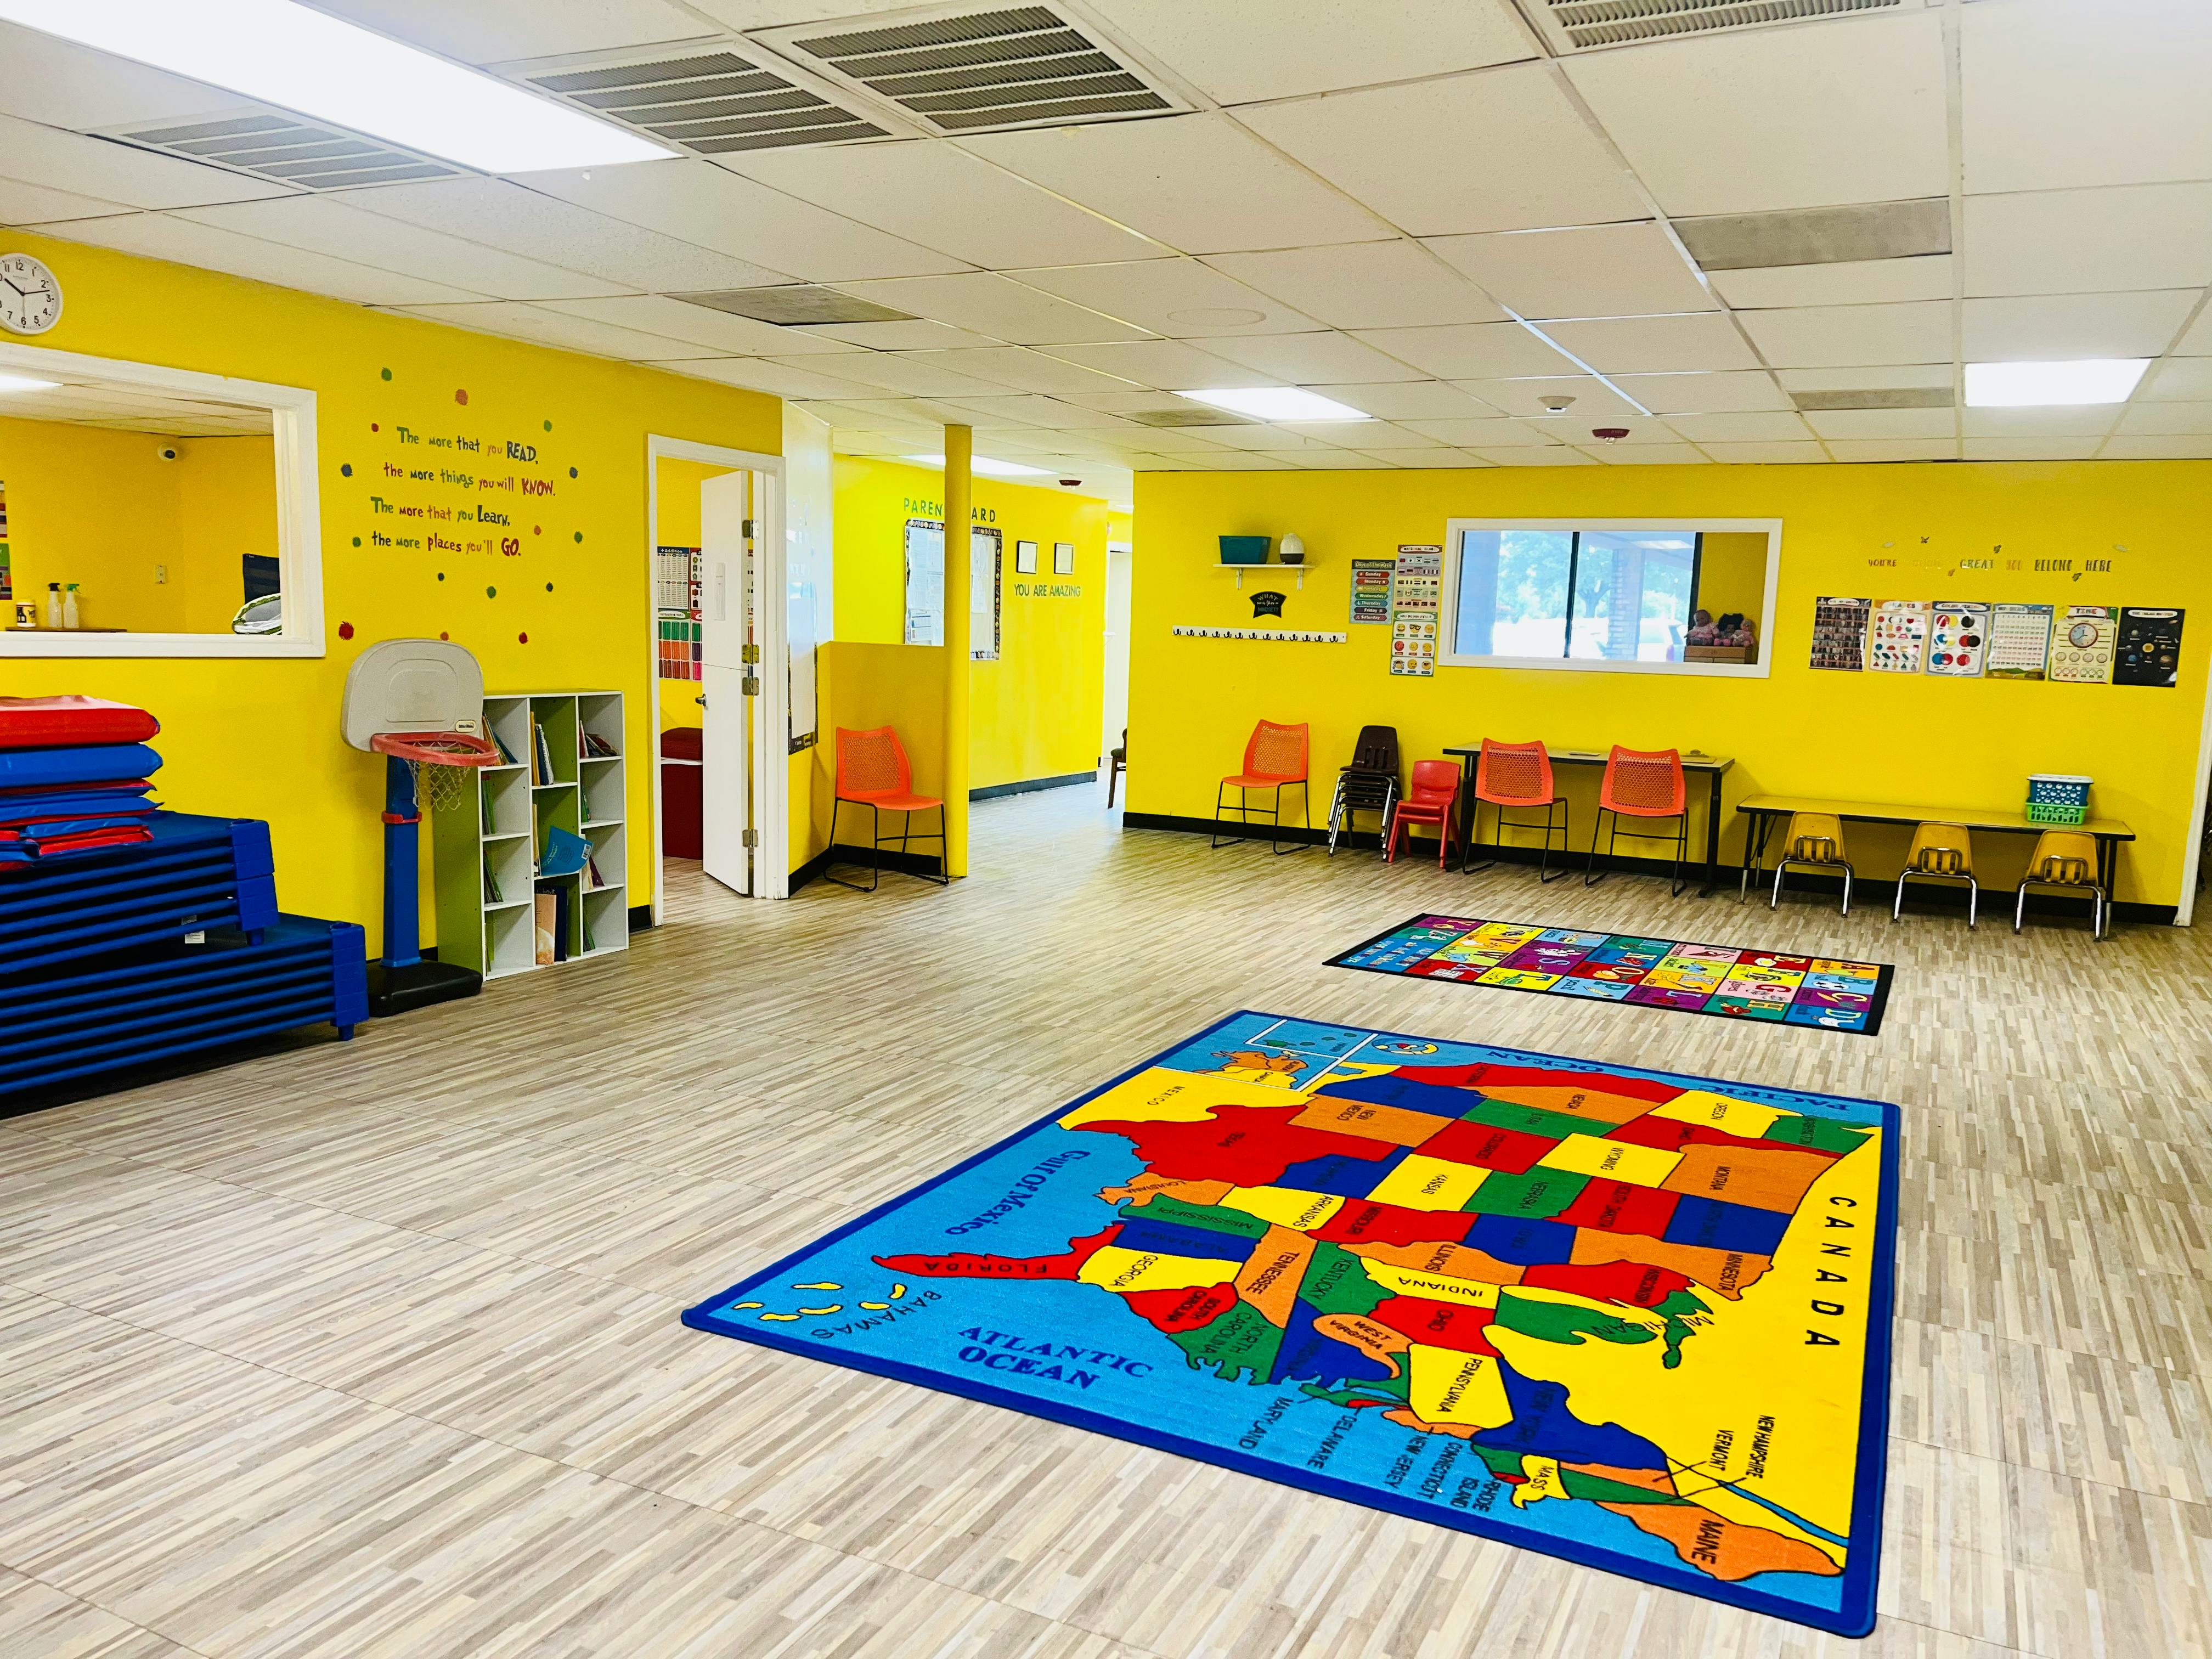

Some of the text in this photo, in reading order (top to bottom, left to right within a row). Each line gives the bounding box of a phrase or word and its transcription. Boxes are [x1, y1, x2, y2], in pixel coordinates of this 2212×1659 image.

[4, 264, 10, 272] 11
[16, 262, 24, 270] 12
[41, 280, 46, 288] 2
[46, 294, 51, 302] 3
[7, 311, 13, 319] 7
[21, 317, 26, 325] 6
[397, 426, 419, 444] The
[456, 436, 479, 453] that
[488, 445, 503, 456] you
[507, 441, 538, 465] READ,
[383, 462, 403, 477] the
[440, 469, 473, 488] things
[479, 477, 494, 491] you
[497, 477, 514, 492] will
[522, 477, 556, 496] KNOW.
[370, 496, 393, 514] The
[427, 505, 452, 521] that
[458, 510, 473, 522] you
[904, 498, 943, 516] PAREN
[372, 531, 391, 546] the
[427, 533, 461, 552] places
[466, 540, 493, 555] you'll
[501, 538, 521, 556] GO.
[2086, 560, 2112, 572] HERE
[1014, 584, 1081, 597] YOU ARE AMAZING
[1470, 949, 1510, 960] W
[1638, 939, 1672, 949] M
[1536, 957, 1572, 966] S
[1622, 952, 1657, 961] N
[1773, 955, 1806, 964] E
[1449, 963, 1489, 973] X
[1515, 972, 1554, 981] T
[1608, 966, 1647, 975] O
[1840, 963, 1875, 972] A
[1556, 979, 1583, 990] pencil
[1590, 981, 1629, 991] P
[1754, 983, 1792, 994] G
[1836, 977, 1873, 985] B
[1664, 990, 1702, 1000] L
[1746, 999, 1785, 1011] H
[1829, 991, 1867, 1002] C
[1822, 1008, 1861, 1020] D
[1486, 1051, 1604, 1072] OCEAN
[1147, 1086, 1185, 1105] MEXICO
[1566, 1094, 1587, 1109] NEVADA
[1698, 1086, 1850, 1110] PACIFIC
[1711, 1103, 1728, 1120] OREGON
[1600, 1147, 1625, 1170] WYOMING
[1421, 1173, 1449, 1195] KANSAS
[1710, 1166, 1731, 1190] MONTANA
[945, 1150, 1091, 1234] Gulf Of Mexico
[1517, 1180, 1549, 1210] NEBRASKA
[1157, 1206, 1254, 1229] MISSISSIPPI
[1293, 1195, 1335, 1228] ARKANSAS
[923, 1262, 1047, 1274] FLORIDA
[1425, 1243, 1458, 1272] ILLINOIS
[1109, 1255, 1158, 1286] GEORGIA
[1245, 1252, 1300, 1295] TENNESSEE
[1306, 1259, 1352, 1300] KENTUCKY
[1718, 1252, 1744, 1291] MINNESOTA
[1805, 1197, 1858, 1346] CANADA
[1398, 1277, 1482, 1297] INDIANA
[1634, 1267, 1661, 1303] WISCONSIN
[810, 1290, 943, 1339] BAHAMAS
[1427, 1310, 1454, 1331] OHIO
[1200, 1312, 1252, 1353] CAROLINA
[1229, 1321, 1268, 1354] NORTH
[1329, 1320, 1383, 1350] VIRGINIA
[1353, 1321, 1392, 1340] WEST
[957, 1327, 1154, 1378] ATLANTIC
[958, 1346, 1101, 1390] OCEAN
[1436, 1357, 1483, 1412] PENNSYLVANIA
[1239, 1396, 1294, 1449] MARYLAND
[1307, 1415, 1357, 1470] DELAWARE
[1406, 1435, 1430, 1455] NEW
[1709, 1429, 1734, 1472] VERMONT
[1746, 1414, 1775, 1479] NEW HAMPSHIRE
[1418, 1442, 1463, 1499] CONNECTICUT
[1531, 1465, 1557, 1491] MASS
[1451, 1477, 1480, 1508] ISLAND
[1472, 1480, 1502, 1513] RHODE
[1691, 1519, 1724, 1565] MAINE
